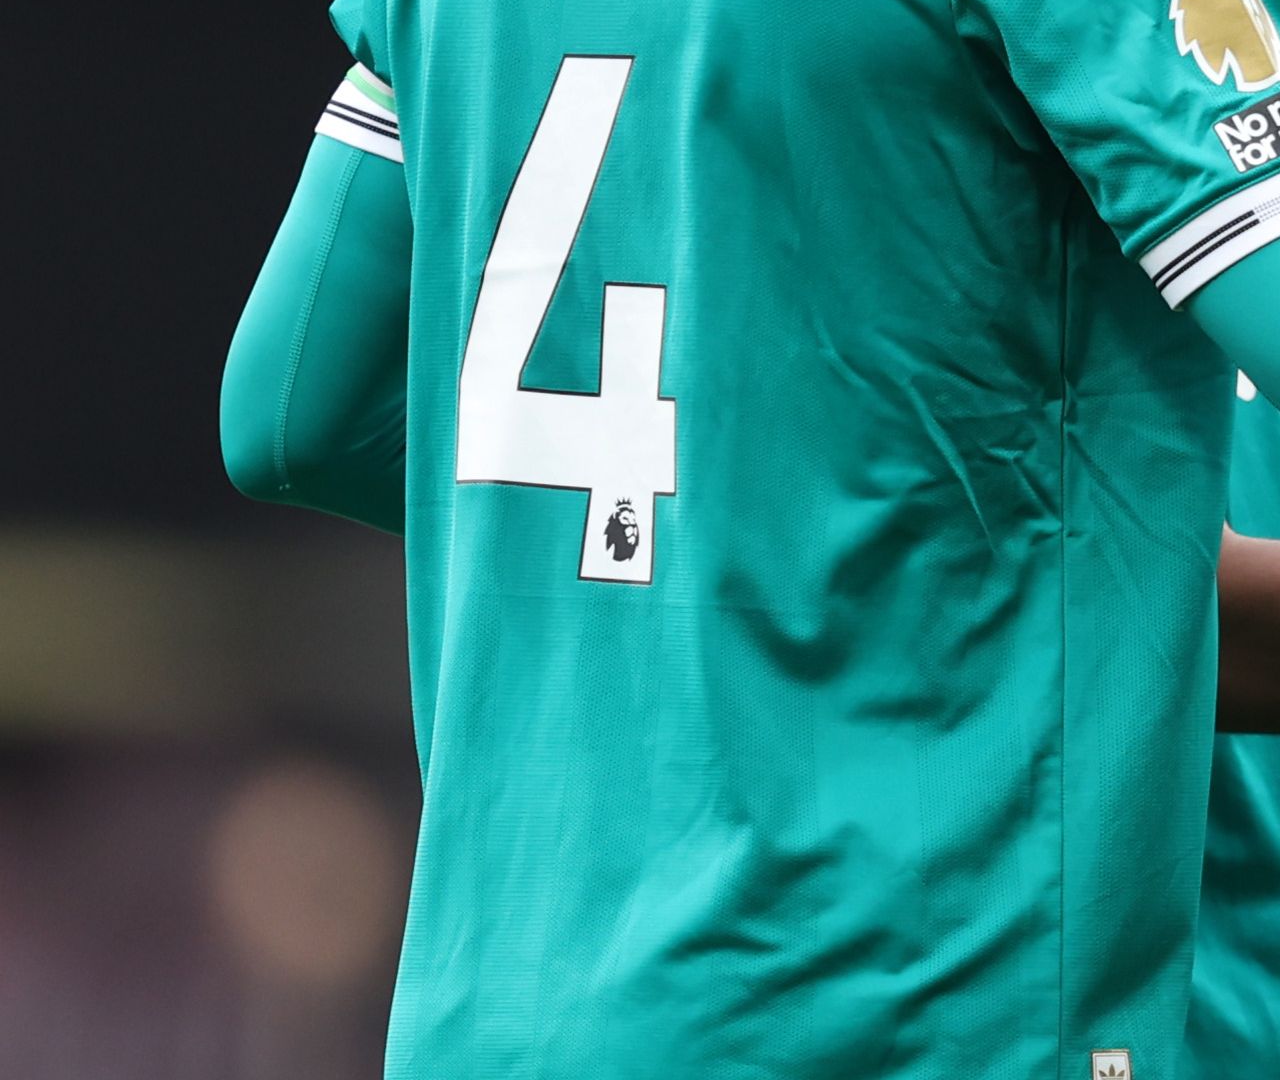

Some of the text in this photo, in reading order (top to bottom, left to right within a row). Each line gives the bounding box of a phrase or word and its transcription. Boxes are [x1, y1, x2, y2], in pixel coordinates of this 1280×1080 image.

[1213, 113, 1268, 151] No
[1229, 134, 1277, 172] for
[456, 54, 677, 585] 4
